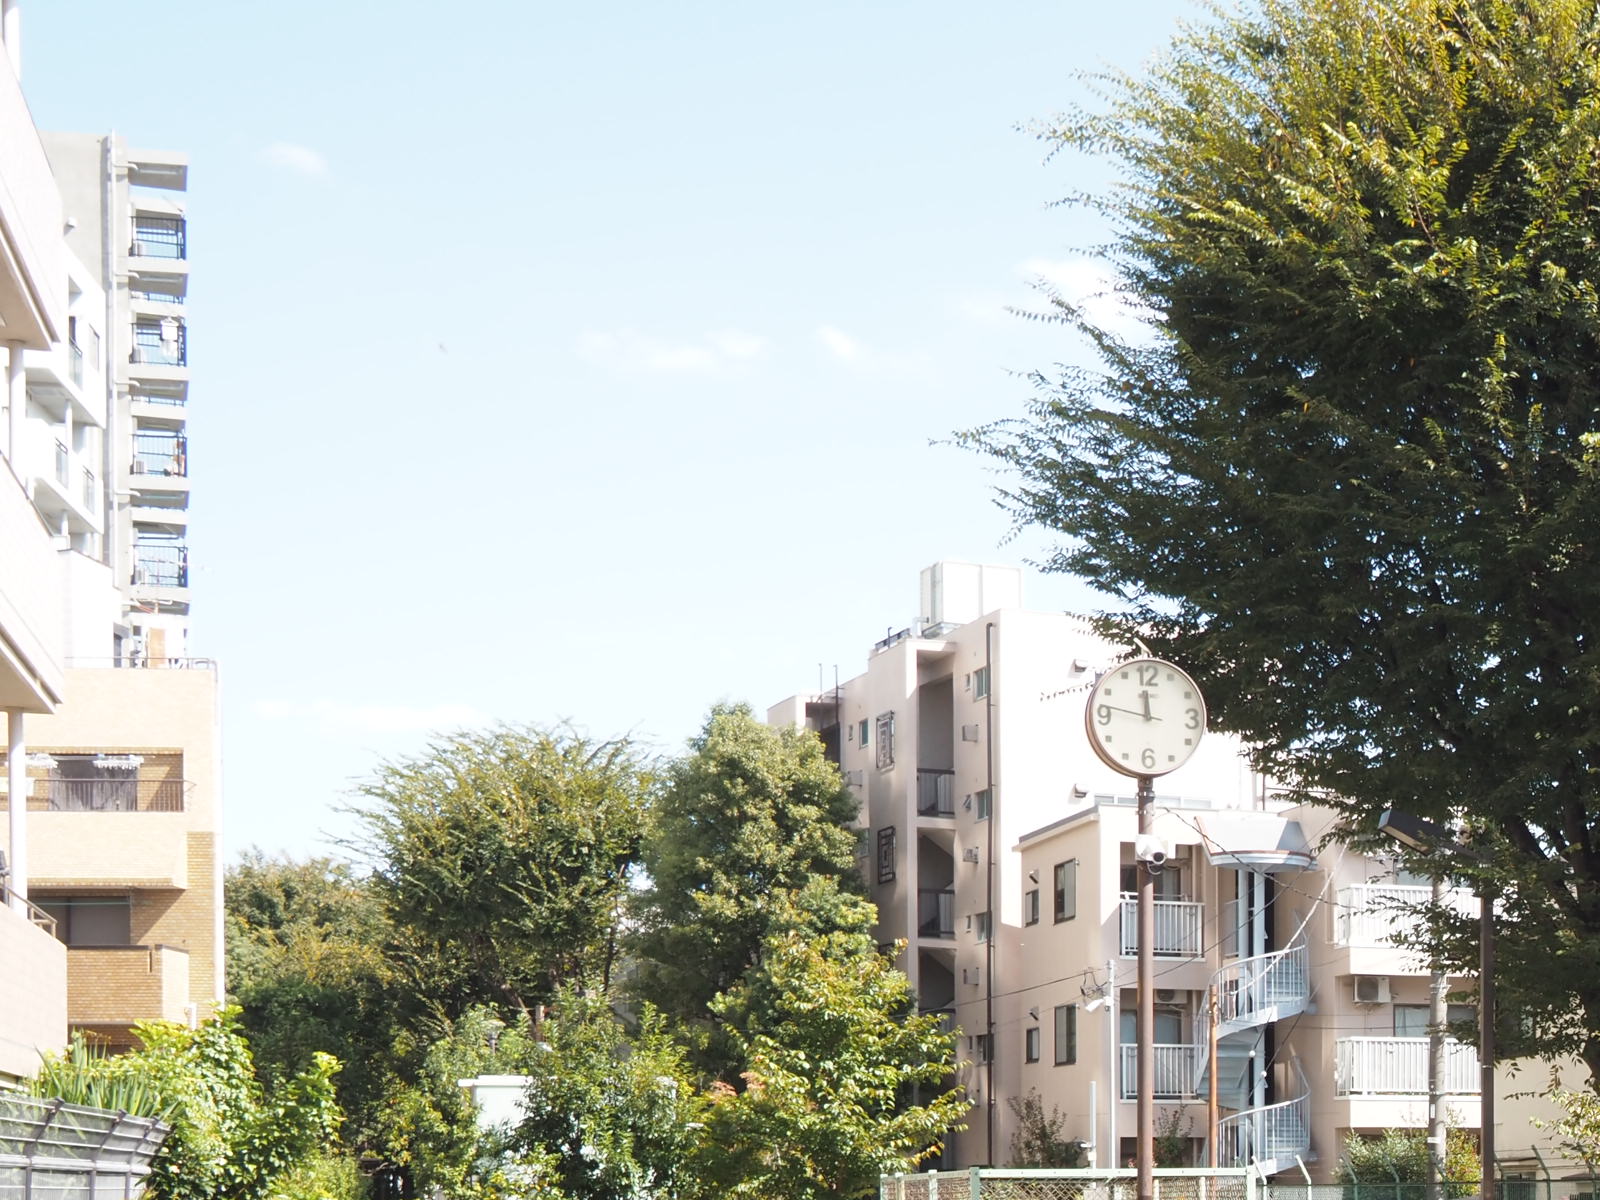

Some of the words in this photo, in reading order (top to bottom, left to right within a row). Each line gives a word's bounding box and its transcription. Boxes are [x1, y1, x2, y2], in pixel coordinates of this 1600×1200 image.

[1136, 665, 1158, 687] 12
[1097, 704, 1112, 726] 9
[1185, 708, 1200, 730] 3
[1141, 748, 1156, 769] 6
